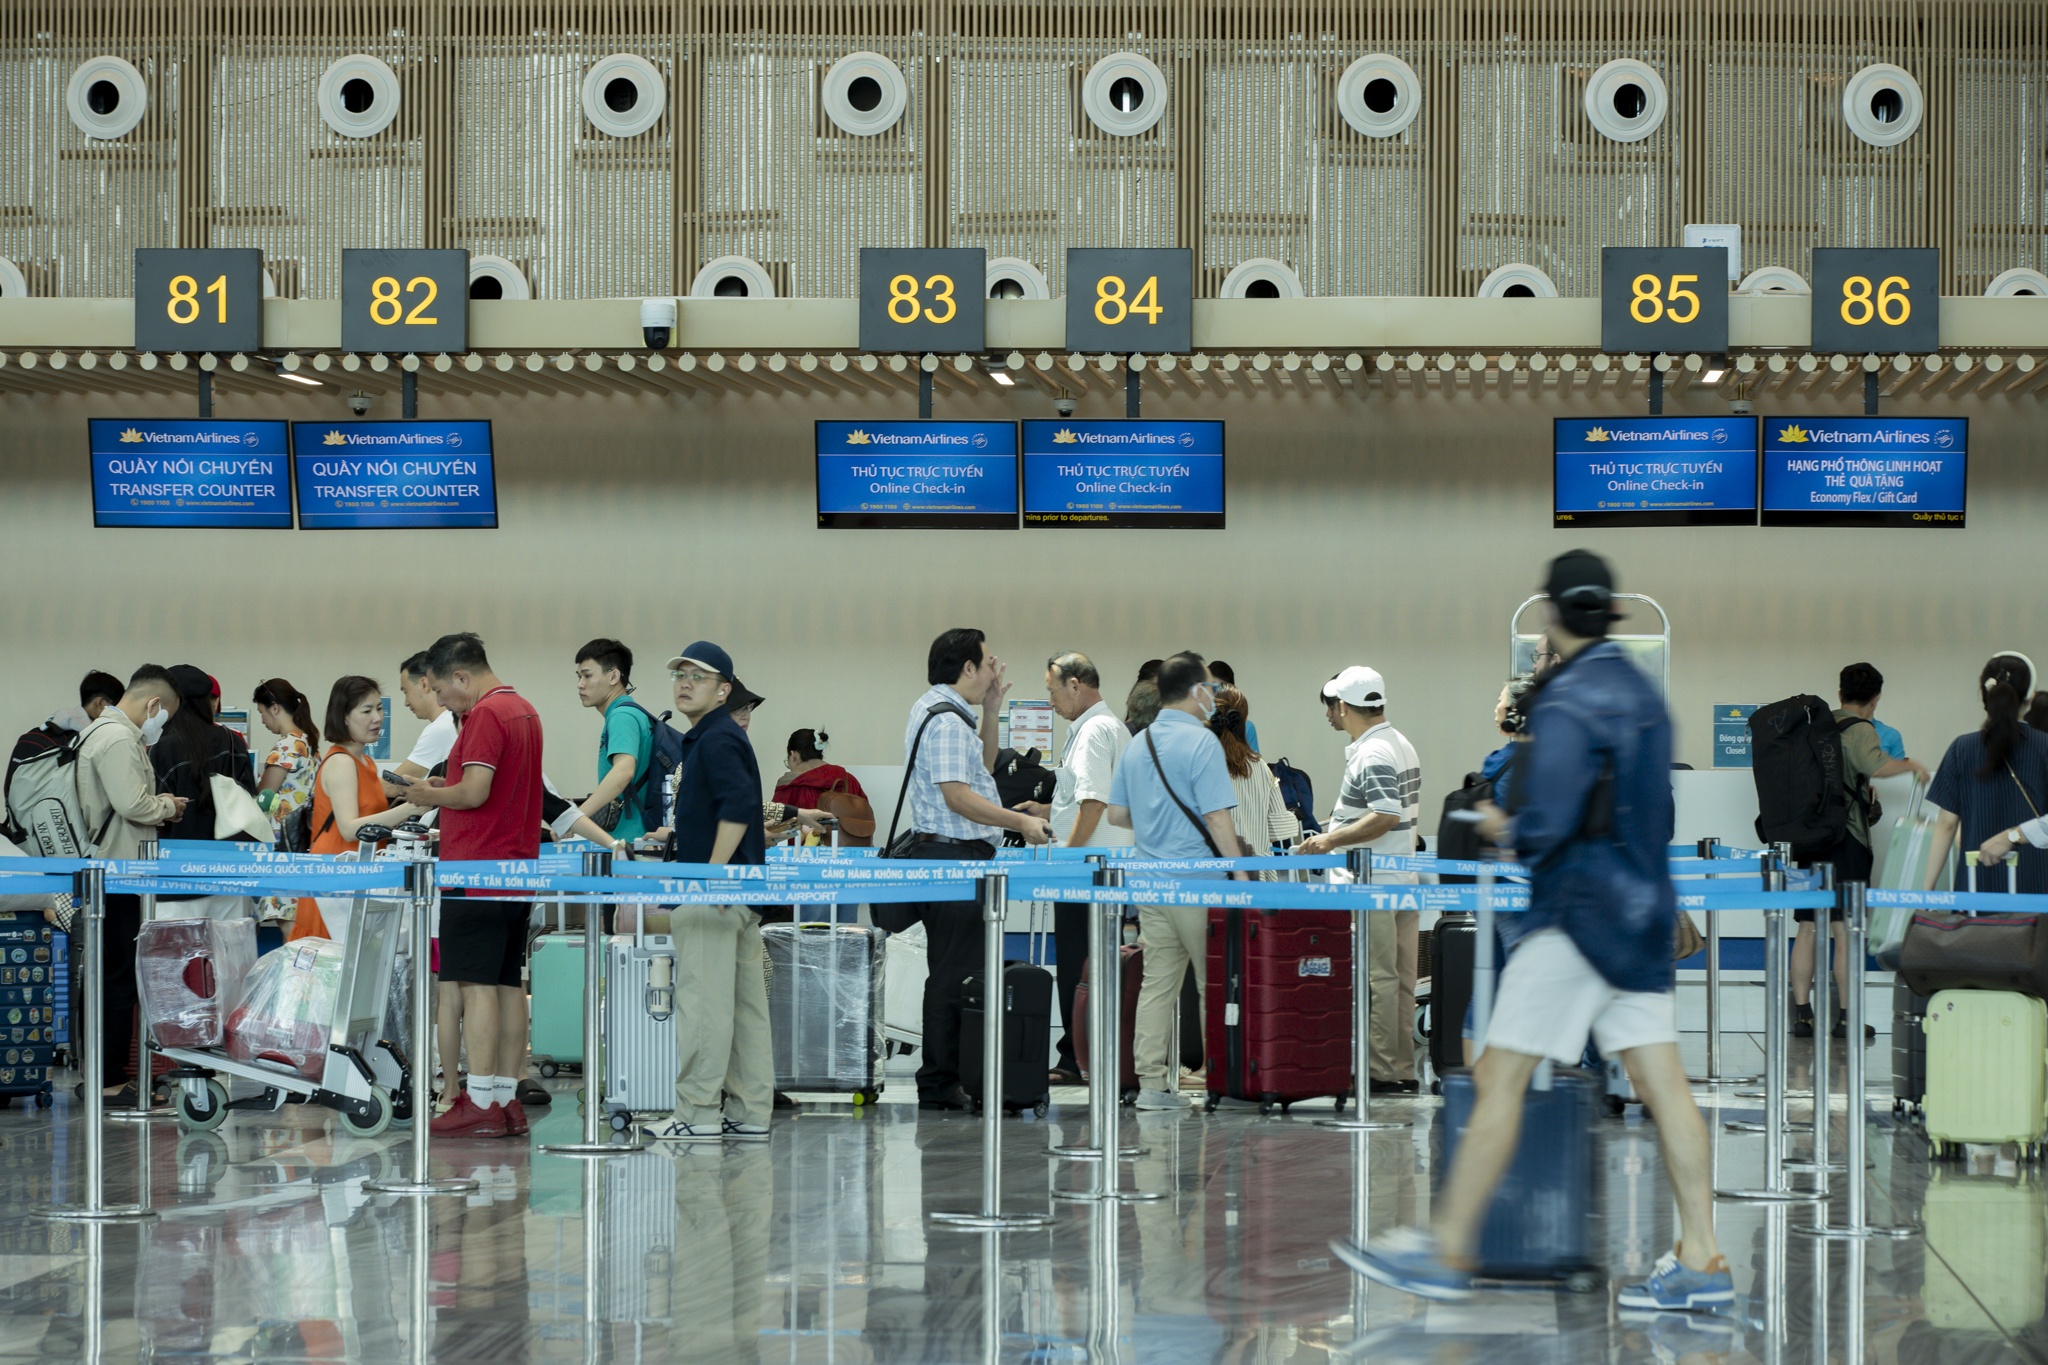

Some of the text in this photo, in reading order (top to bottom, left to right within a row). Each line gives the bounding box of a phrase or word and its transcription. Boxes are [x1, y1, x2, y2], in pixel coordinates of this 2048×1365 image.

[167, 275, 226, 324] 81
[370, 276, 438, 325] 82
[888, 274, 956, 324] 83
[1094, 276, 1163, 325] 84
[1630, 274, 1700, 324] 85
[1840, 276, 1911, 326] 86
[144, 432, 194, 443] Vietnam
[194, 432, 240, 444] Airlines
[347, 433, 398, 445] Vietnam
[398, 433, 443, 445] Airlines
[871, 433, 922, 444] Vietnam
[922, 433, 968, 445] Airlines
[1078, 432, 1129, 444] Vietnam
[1130, 432, 1175, 444] Airlines
[1610, 430, 1662, 441] Vietnam
[1662, 430, 1708, 441] Airlines
[1809, 430, 1874, 443] Vietnam
[1874, 430, 1930, 444] Airlines
[108, 457, 158, 474] QUẦY
[163, 457, 194, 474] NỐI
[312, 459, 362, 476] QUẦY
[367, 458, 398, 476] NỐI
[851, 464, 984, 480] THỦ TỤC TRỰC TUYẾN
[1057, 462, 1190, 479] THỦ TỤC TRỰC TUYẾN
[1589, 460, 1722, 477] THỦ TỤC TRỰC TUYẾN
[1787, 456, 1942, 475] HẠNG PHỔ THÔNG LINH HOẠT
[1607, 478, 1704, 492] Online Check-in
[1825, 472, 1904, 490] THẺ QUÀ TẶNG
[109, 483, 276, 497] TRANSFER COUNTER
[314, 484, 480, 498] TRANSFER COUNTER
[870, 482, 966, 494] Online Check-in
[1076, 482, 1172, 494] Online Check-in
[390, 500, 459, 508] www.vietnamairlines.com
[1649, 500, 1714, 508] www.vietnamairlines.com
[1810, 491, 1918, 506] Economy Flex / Gift Card
[1042, 514, 1059, 522] prior
[1069, 514, 1110, 522] departures.
[1725, 746, 1746, 754] Closed
[552, 844, 587, 854] TIA
[778, 847, 814, 858] TA
[252, 852, 290, 862] TIA
[86, 860, 118, 874] TIA
[180, 861, 384, 874] CẢNG HÀNG KHÔNG QUỐC TẾ TÂN SƠN NHẤT
[497, 861, 529, 874] TIA
[1118, 860, 1236, 870] INTERNATIONAL AIRPORT
[1456, 862, 1475, 872] TAN
[1477, 864, 1498, 872] SON
[723, 865, 764, 880] TIA
[821, 866, 845, 879] CẢNG
[848, 868, 872, 879] HÀNG
[874, 868, 904, 880] KHÔNG
[906, 866, 930, 880] QUỐC
[932, 866, 944, 879] TẾ
[946, 868, 964, 879] TÂN
[966, 867, 984, 879] SƠN
[440, 872, 552, 888] QUỐC TẾ TÂN SƠN NHẤT
[659, 880, 704, 892] TIA
[1128, 880, 1182, 890] SƠN NHẤT
[690, 892, 782, 902] INTERNATIONAL
[785, 891, 838, 902] AIRPORT
[1032, 884, 1254, 906] CẢNG HÀNG KHÔNG QUỐC TẾ TÂN SƠN NHẤT
[1370, 894, 1419, 909] TIA
[1677, 896, 1706, 906] PORT
[1899, 892, 1923, 904] SƠN
[1486, 896, 1508, 908] TAN
